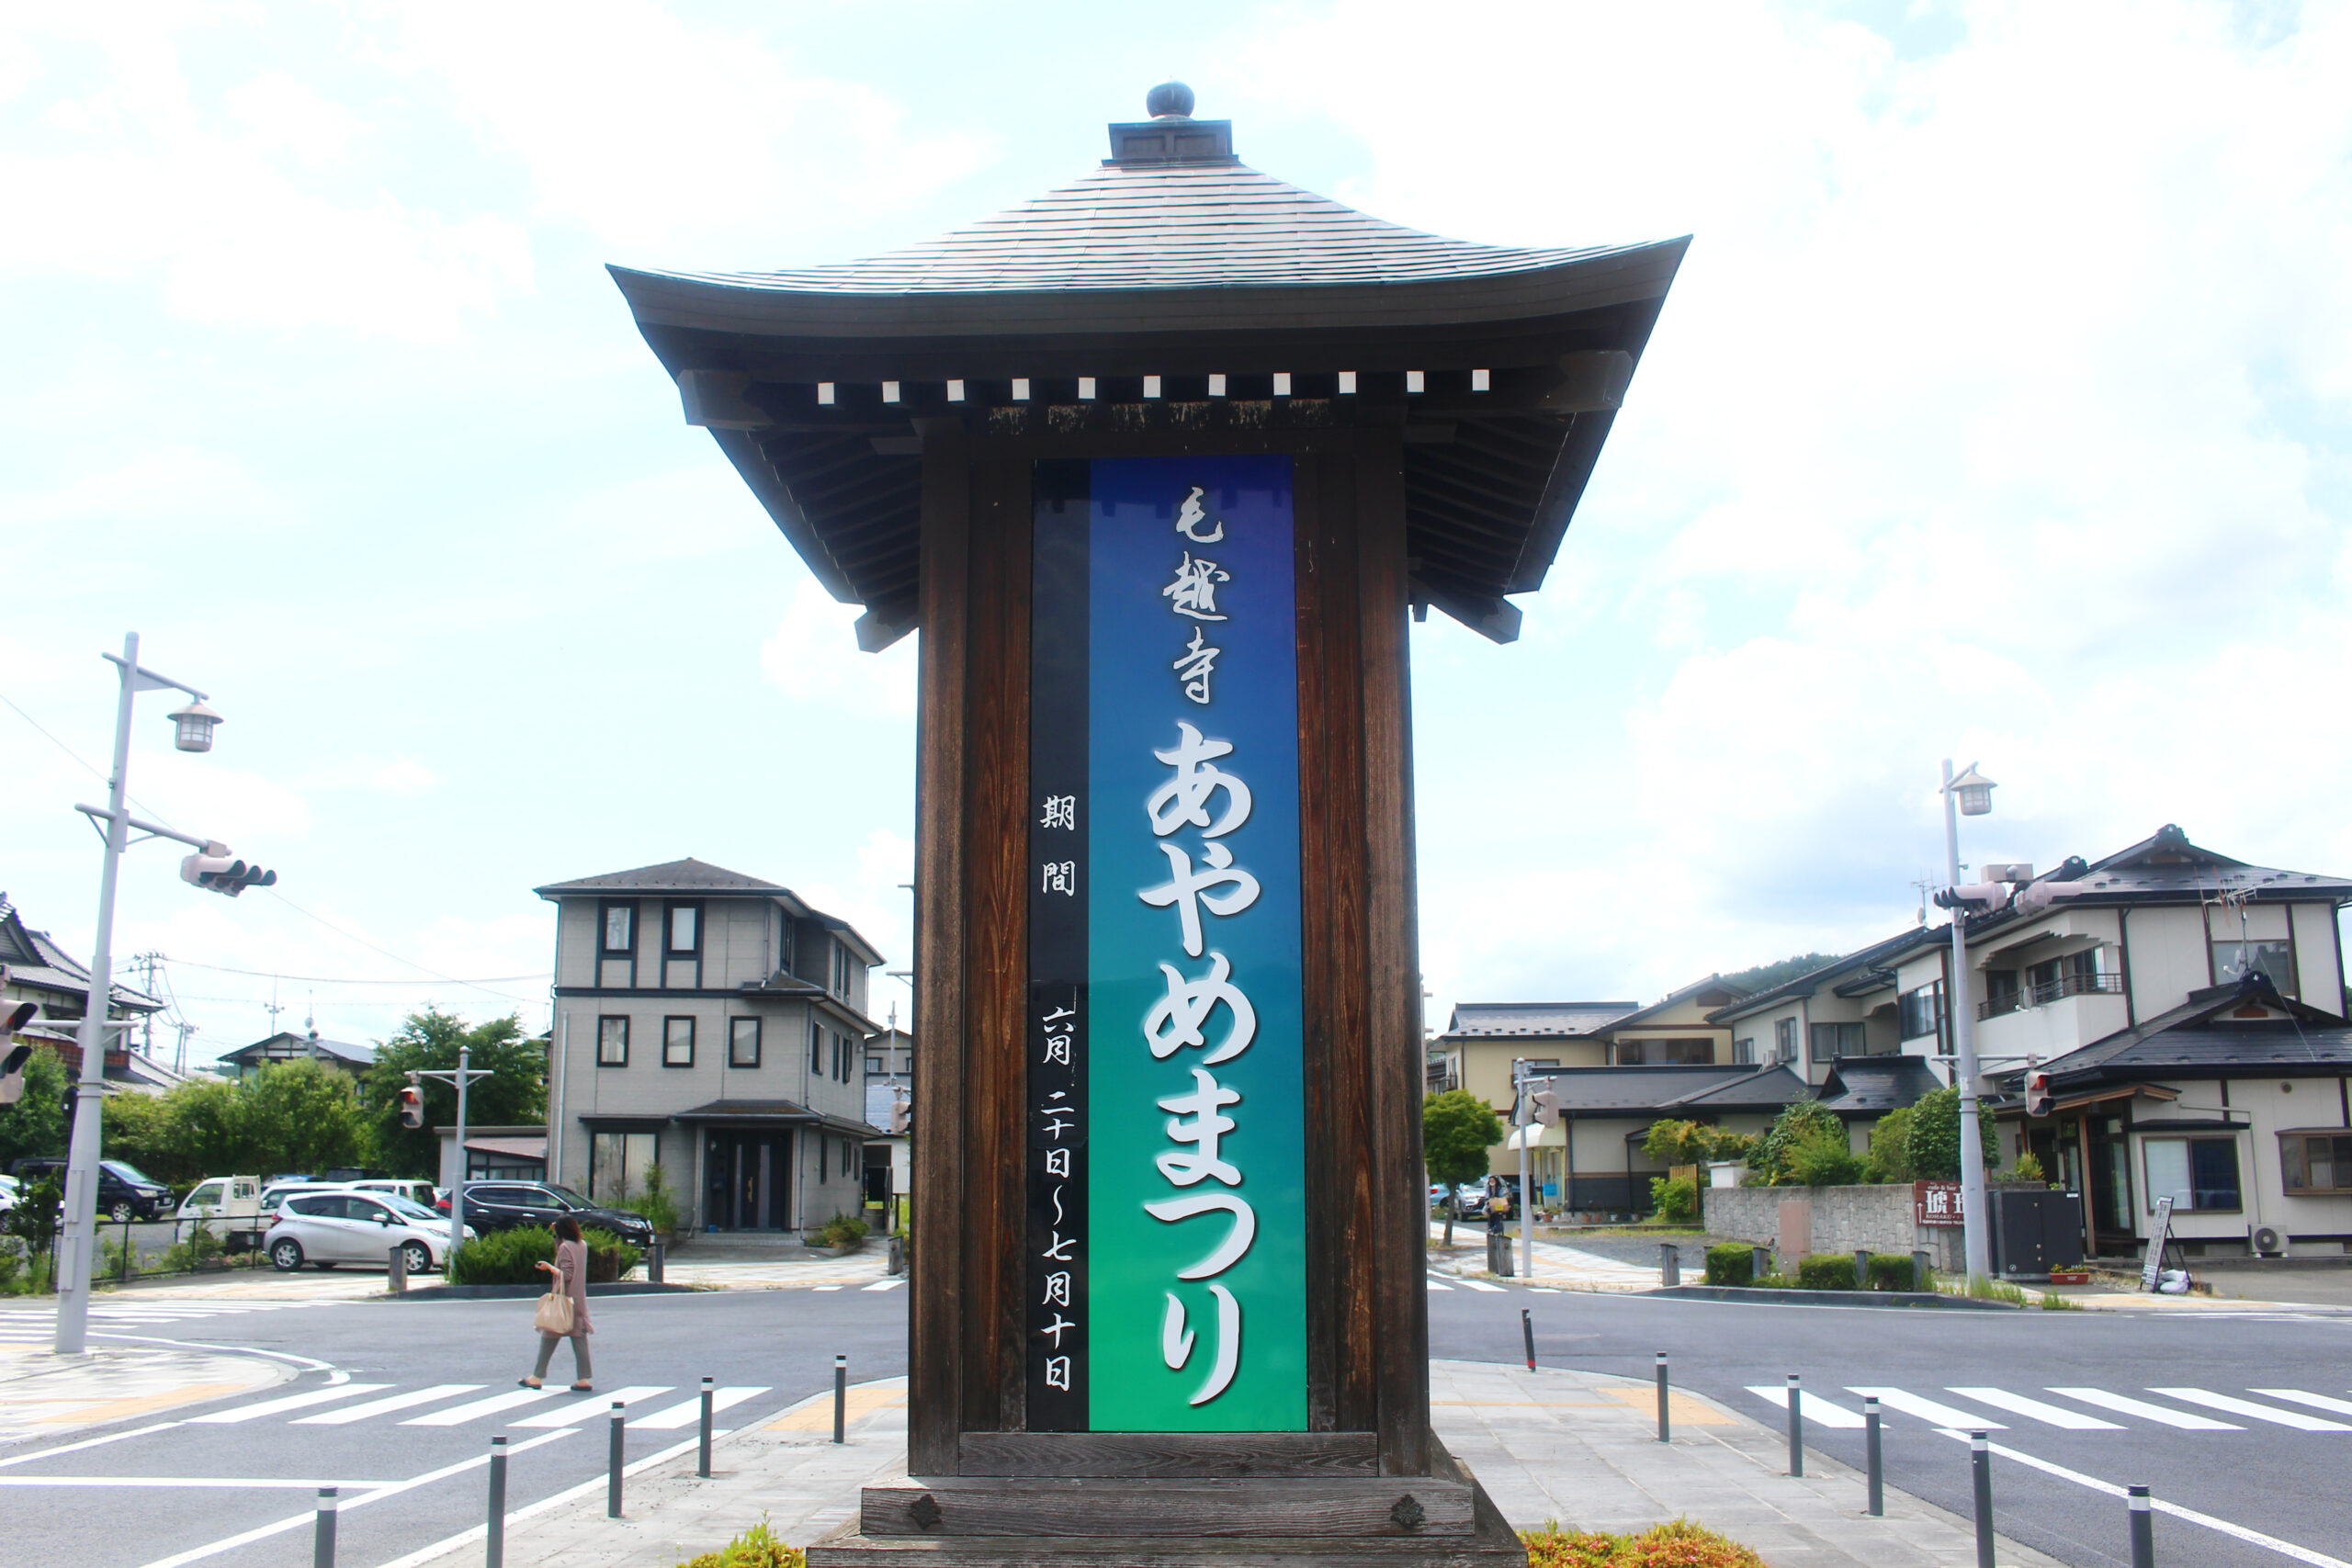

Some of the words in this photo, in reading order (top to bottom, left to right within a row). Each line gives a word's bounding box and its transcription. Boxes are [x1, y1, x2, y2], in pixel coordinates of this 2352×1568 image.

[1162, 487, 1230, 705] 毛越寺
[1039, 795, 1076, 897] 期間
[1138, 721, 1261, 1405] あやめまつり
